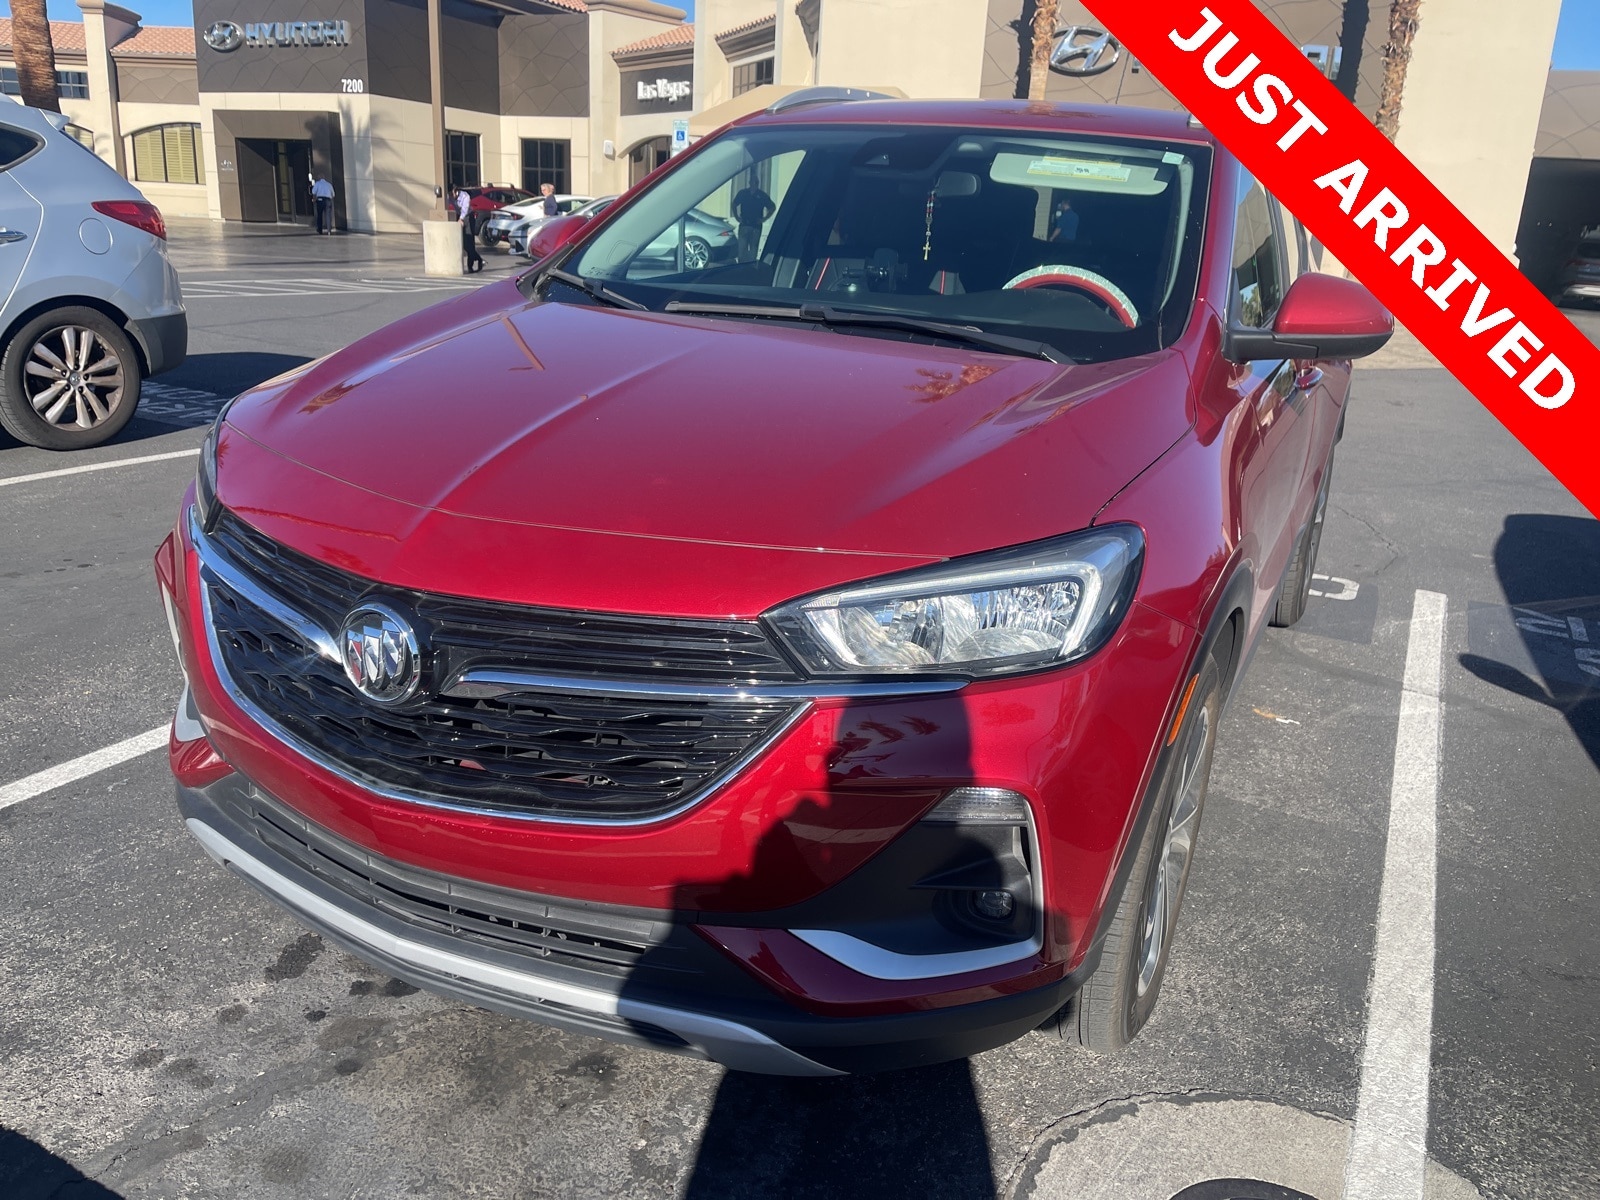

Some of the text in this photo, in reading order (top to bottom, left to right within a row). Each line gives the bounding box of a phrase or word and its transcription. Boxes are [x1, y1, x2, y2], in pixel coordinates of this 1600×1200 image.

[245, 20, 350, 46] HYUNDAI
[341, 79, 363, 93] 7200
[637, 78, 690, 102] Las Vegas
